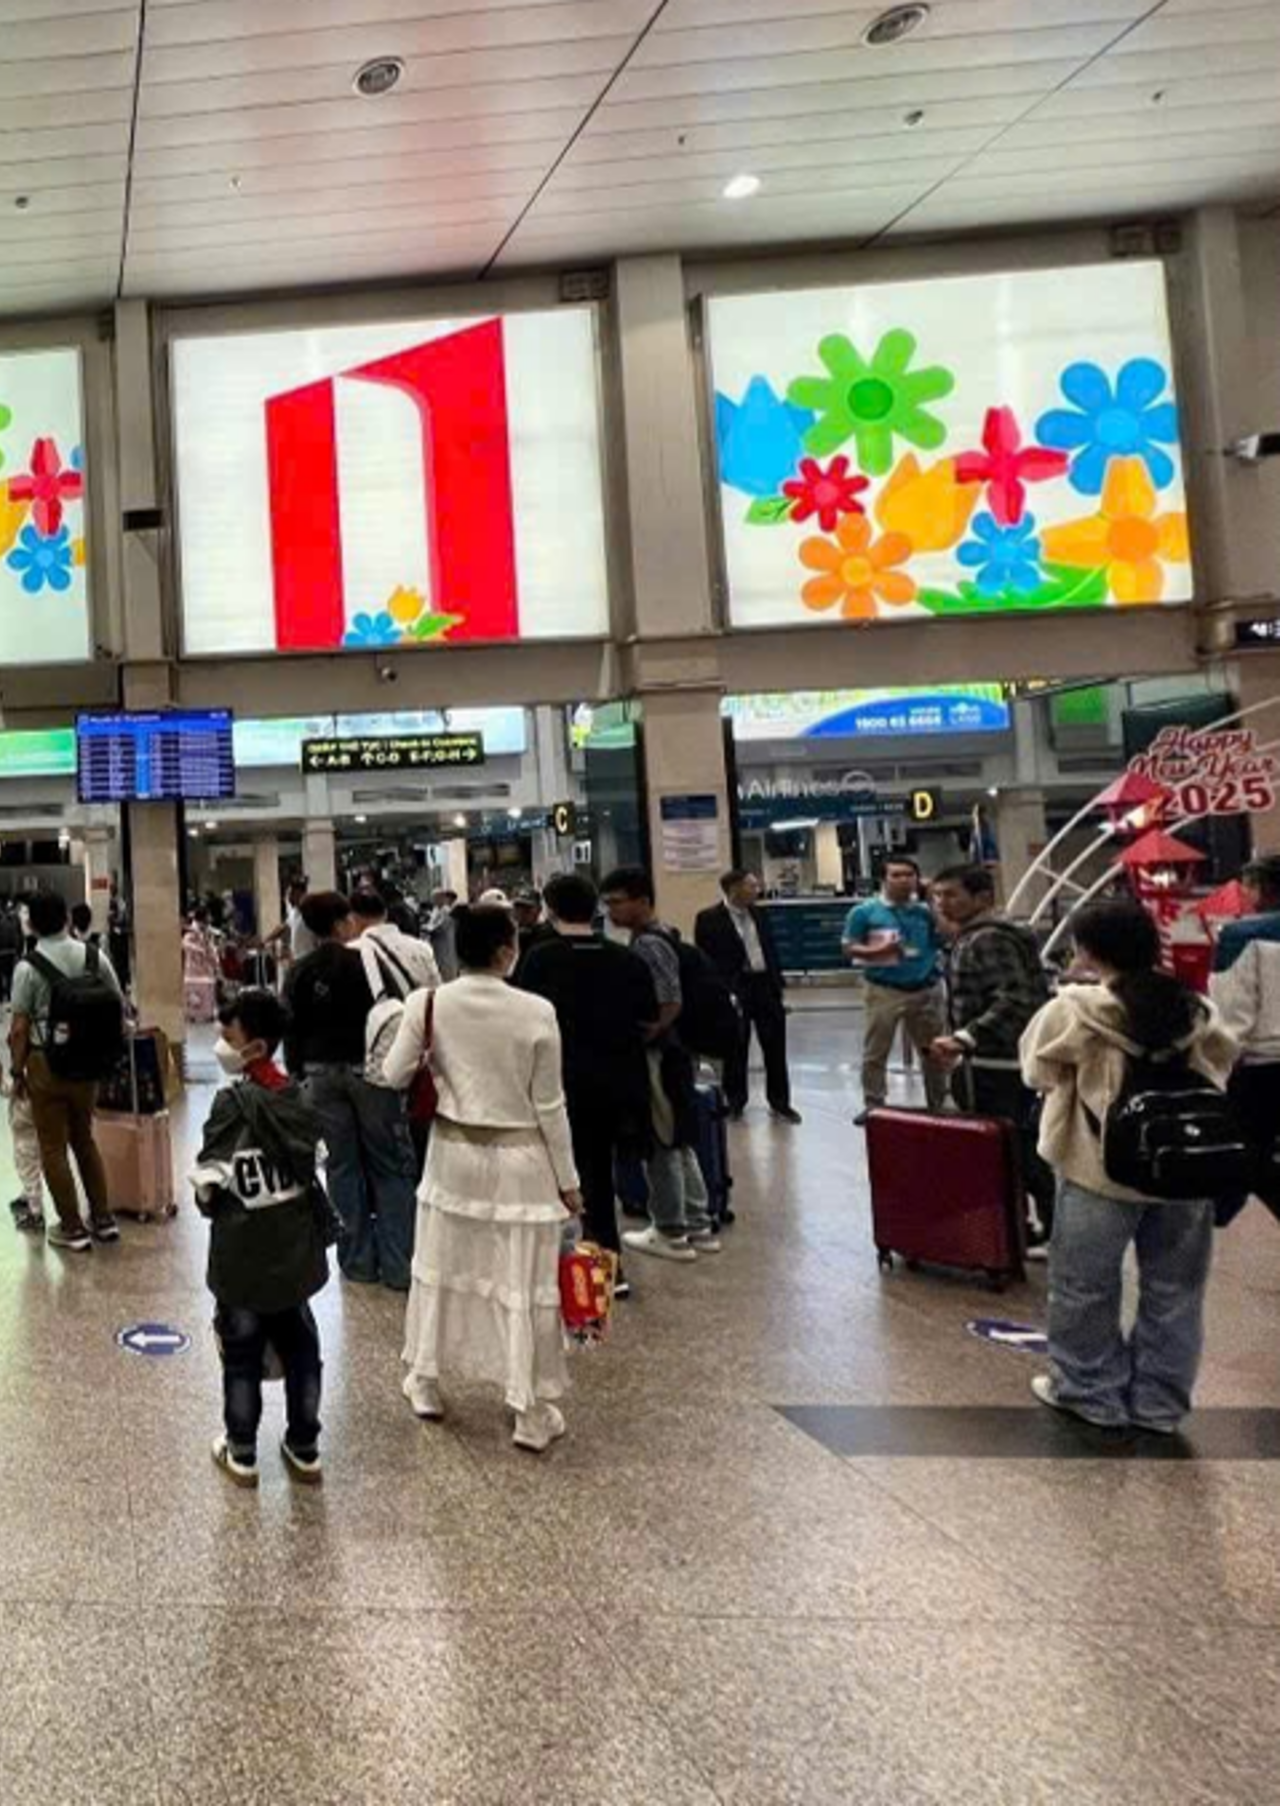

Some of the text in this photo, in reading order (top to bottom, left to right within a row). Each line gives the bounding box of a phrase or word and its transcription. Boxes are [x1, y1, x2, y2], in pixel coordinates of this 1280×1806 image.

[1160, 728, 1252, 753] Happy
[1132, 752, 1274, 786] New Year
[914, 791, 933, 818] D
[1154, 776, 1271, 818] 2025
[555, 806, 568, 833] C
